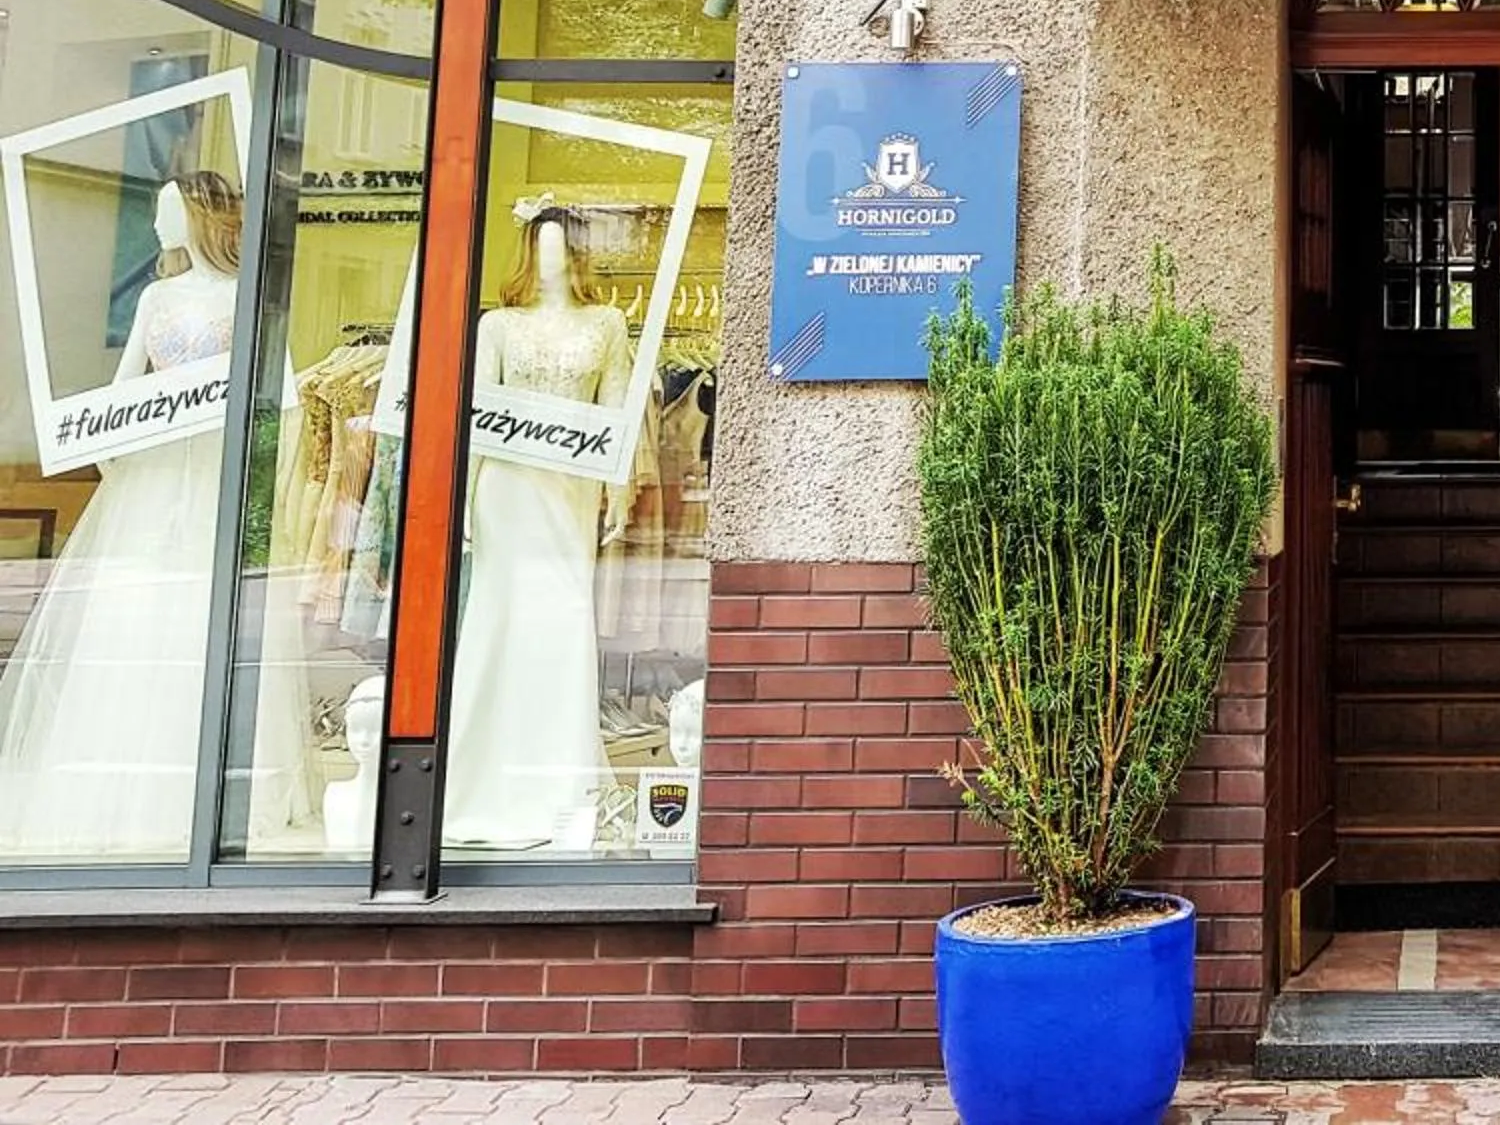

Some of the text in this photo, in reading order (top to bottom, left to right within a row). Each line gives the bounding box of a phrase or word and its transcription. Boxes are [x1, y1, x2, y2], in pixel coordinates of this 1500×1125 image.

[887, 152, 910, 175] H
[338, 171, 357, 187] &
[299, 210, 420, 223] IDAL COLLECTIO
[837, 209, 956, 225] HORNIGOLD
[829, 254, 894, 274] ZIELONEJ
[850, 276, 937, 294] KOPERNIKA 6
[56, 380, 230, 445] #fularażywcz
[652, 786, 687, 797] SOLID
